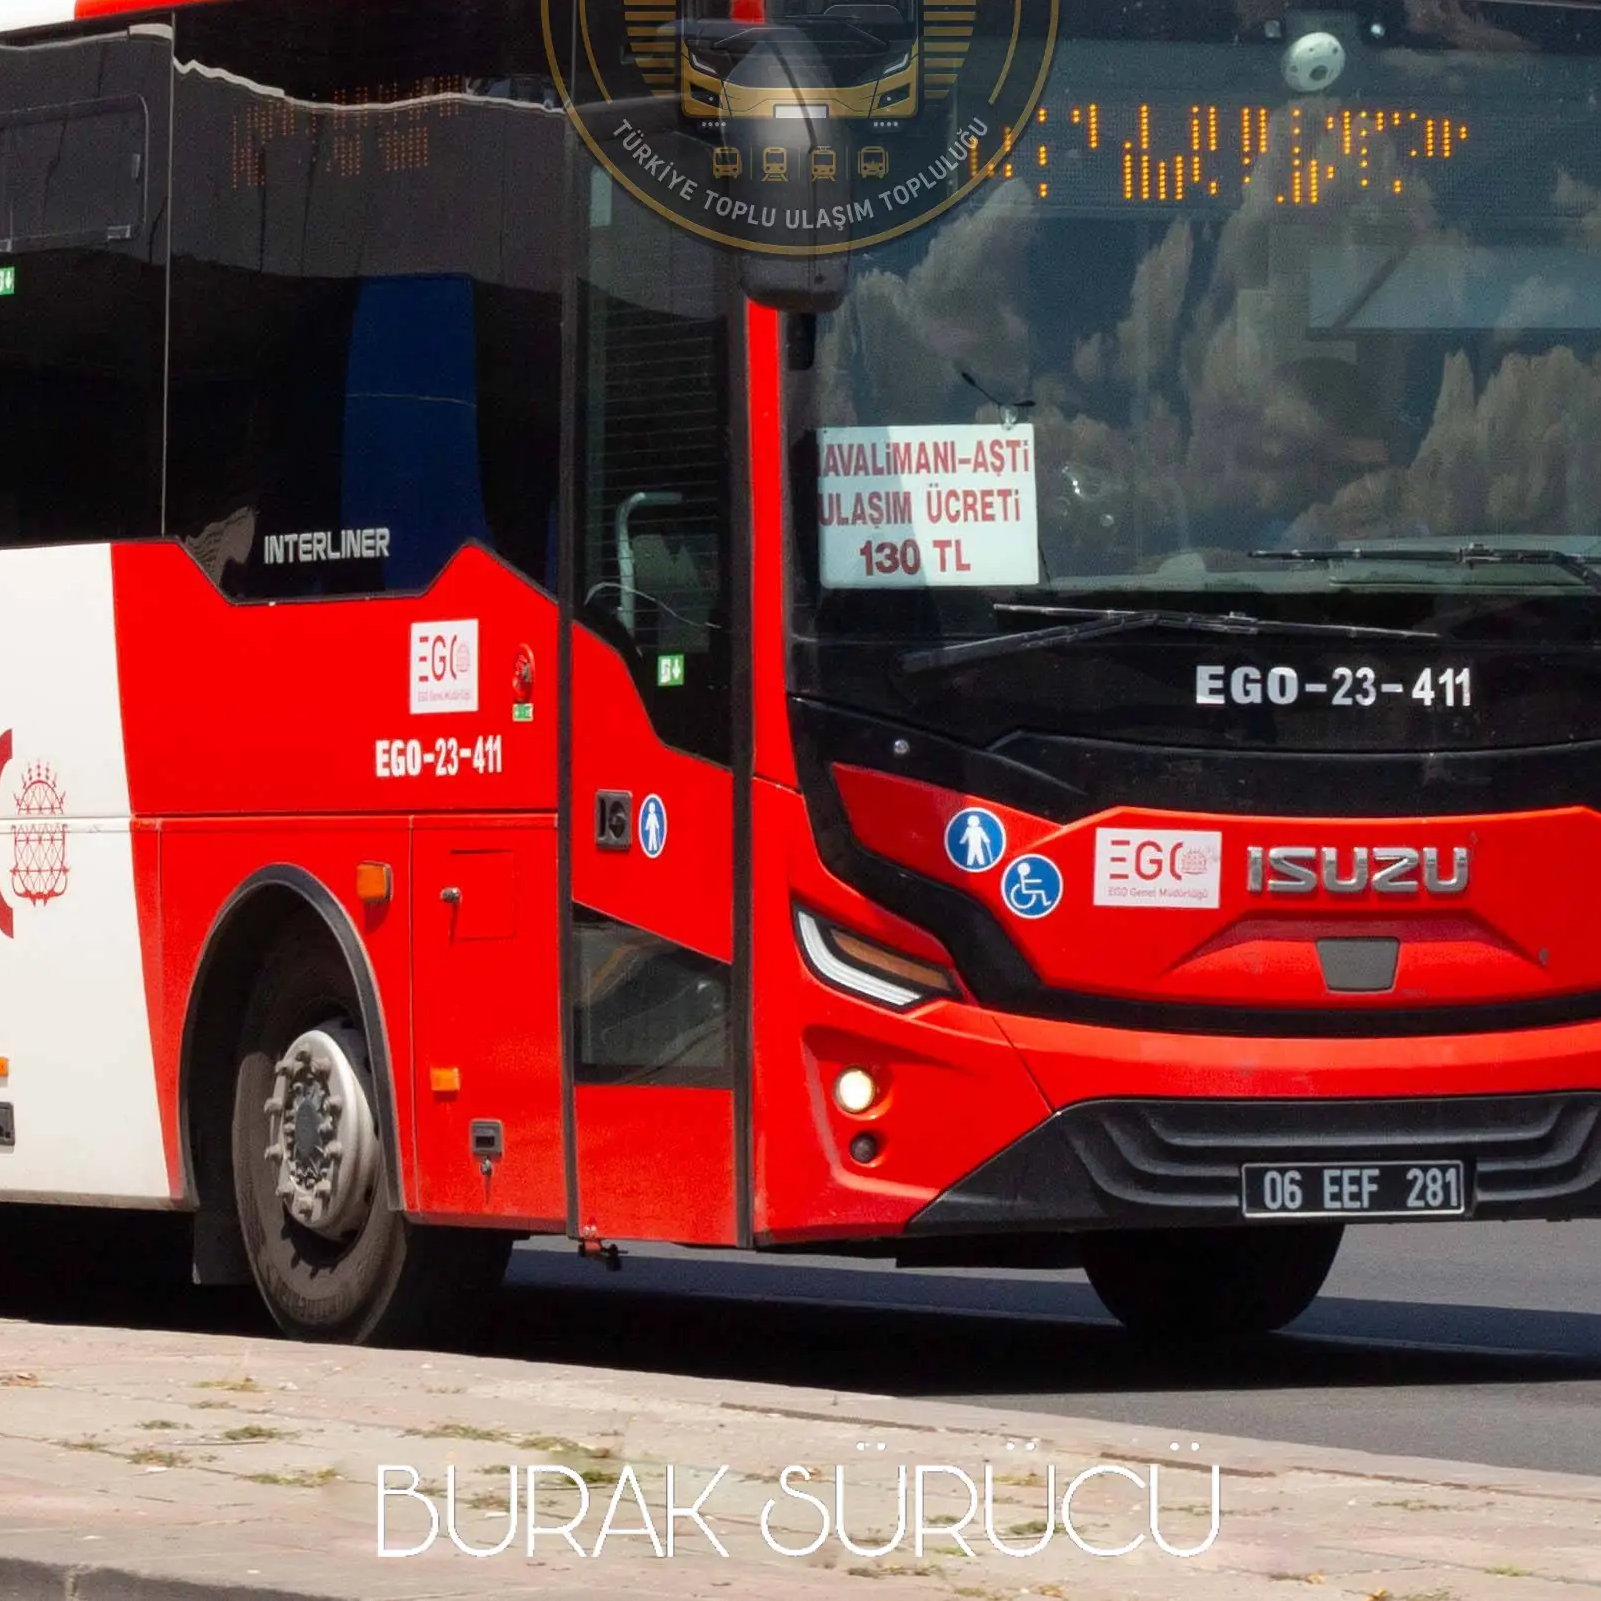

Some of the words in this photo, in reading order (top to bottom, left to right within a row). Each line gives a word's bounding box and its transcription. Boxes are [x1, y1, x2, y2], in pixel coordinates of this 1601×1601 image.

[819, 491, 913, 529] ULAŞIM
[264, 528, 390, 564] INTERLINER
[860, 539, 921, 577] 130
[933, 539, 972, 573] TL
[1196, 665, 1471, 706] EGO-23-411
[375, 735, 502, 778] EGO-23-411
[1247, 847, 1468, 892] ISUZU
[1263, 1170, 1302, 1210] 06
[1323, 1168, 1380, 1208] EEF
[1406, 1167, 1458, 1208] 281
